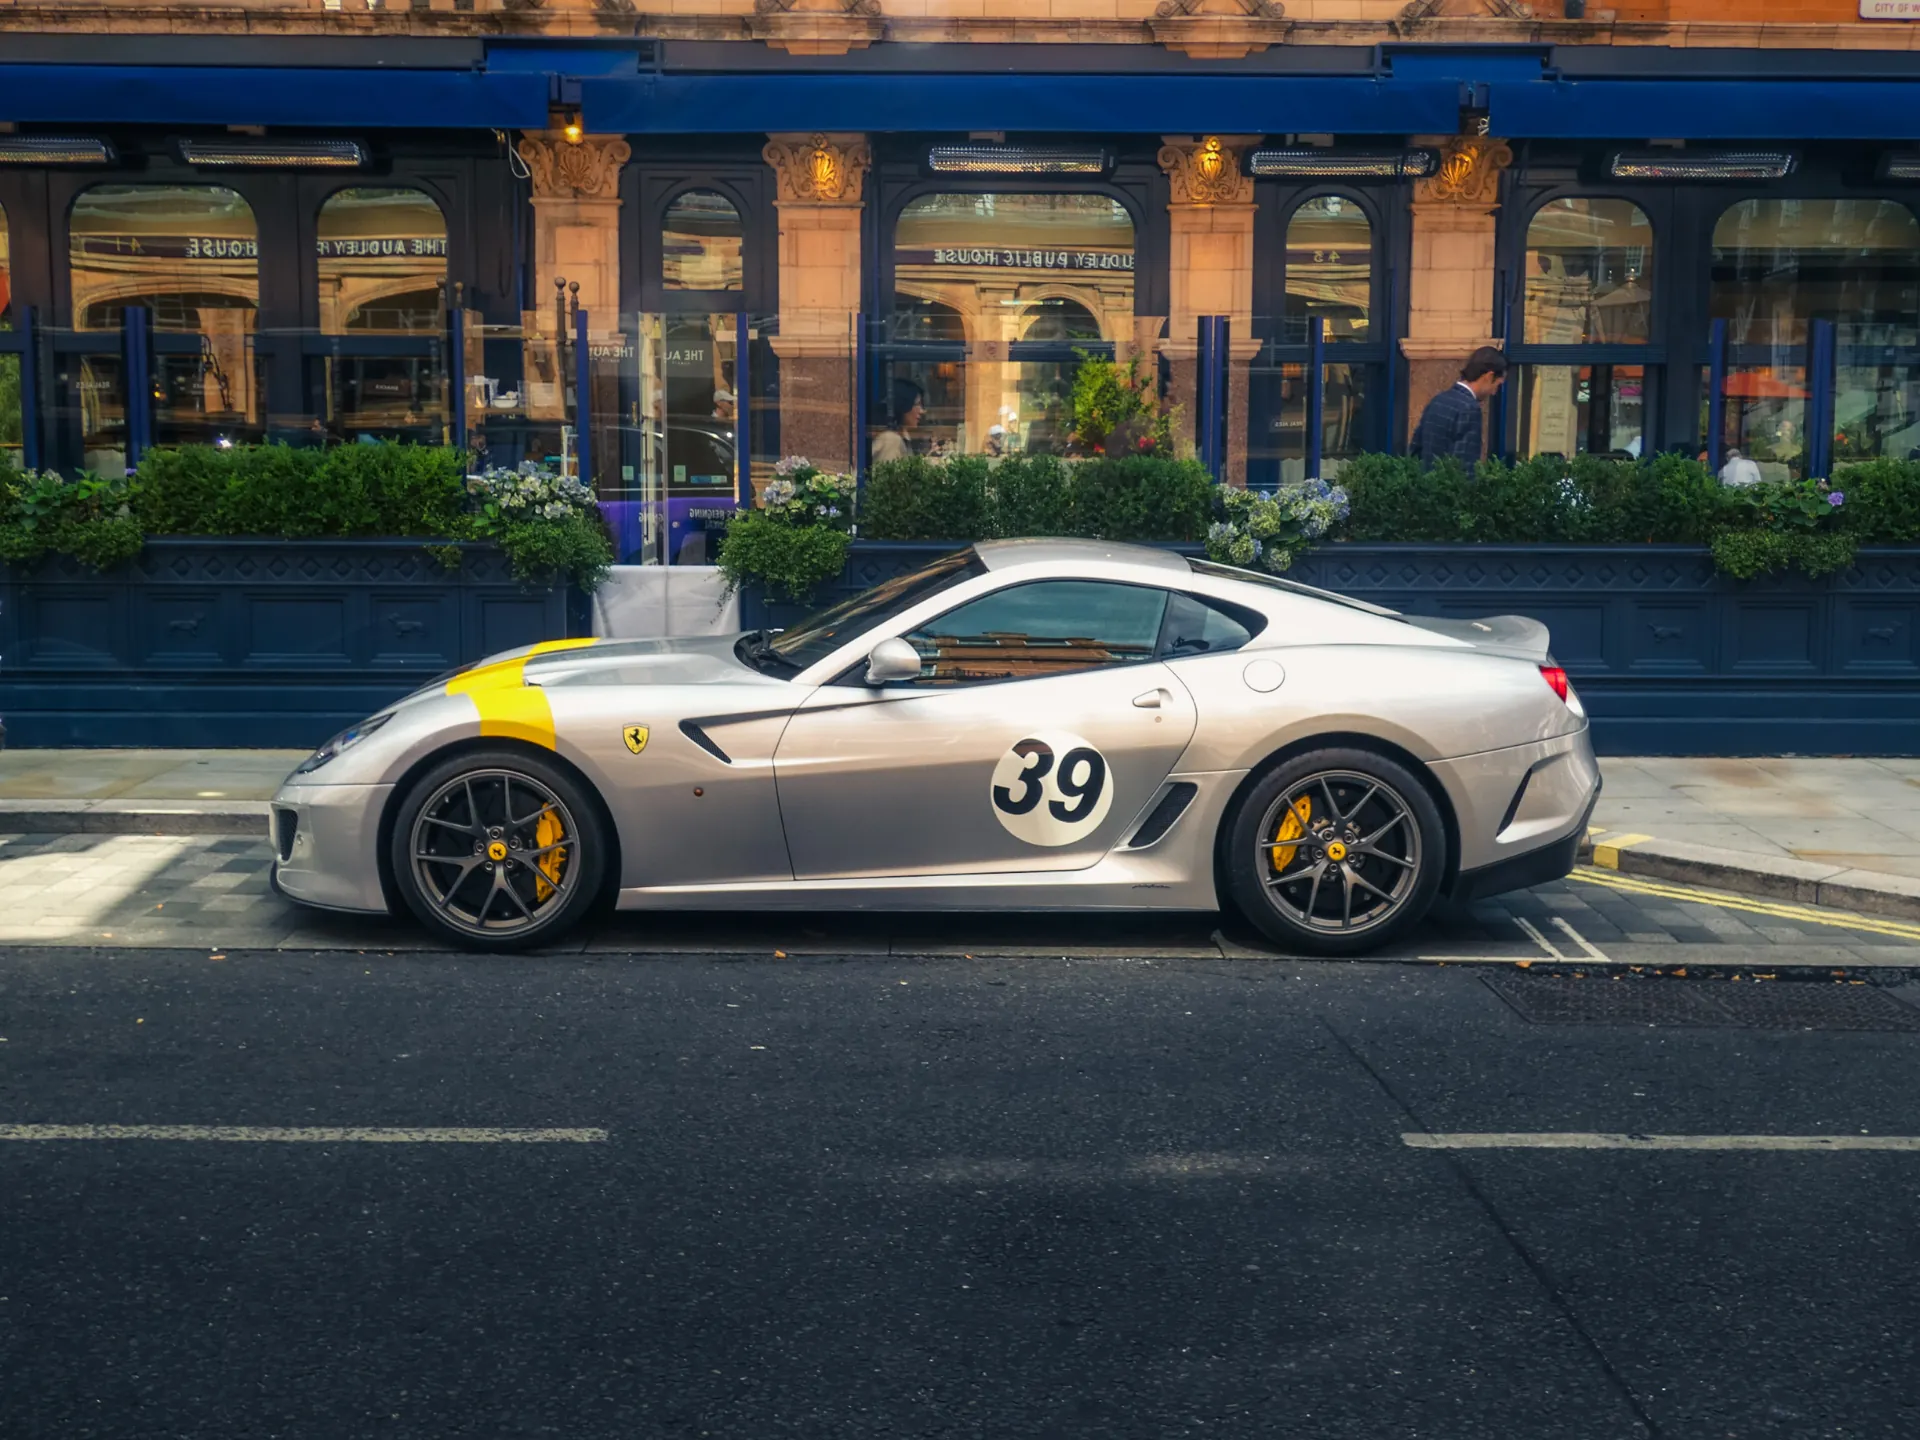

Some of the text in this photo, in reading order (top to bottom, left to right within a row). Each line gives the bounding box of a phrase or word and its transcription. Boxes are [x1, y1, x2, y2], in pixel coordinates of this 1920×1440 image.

[1875, 3, 1895, 13] CITY
[1898, 3, 1909, 13] OF
[993, 738, 1106, 823] 39
